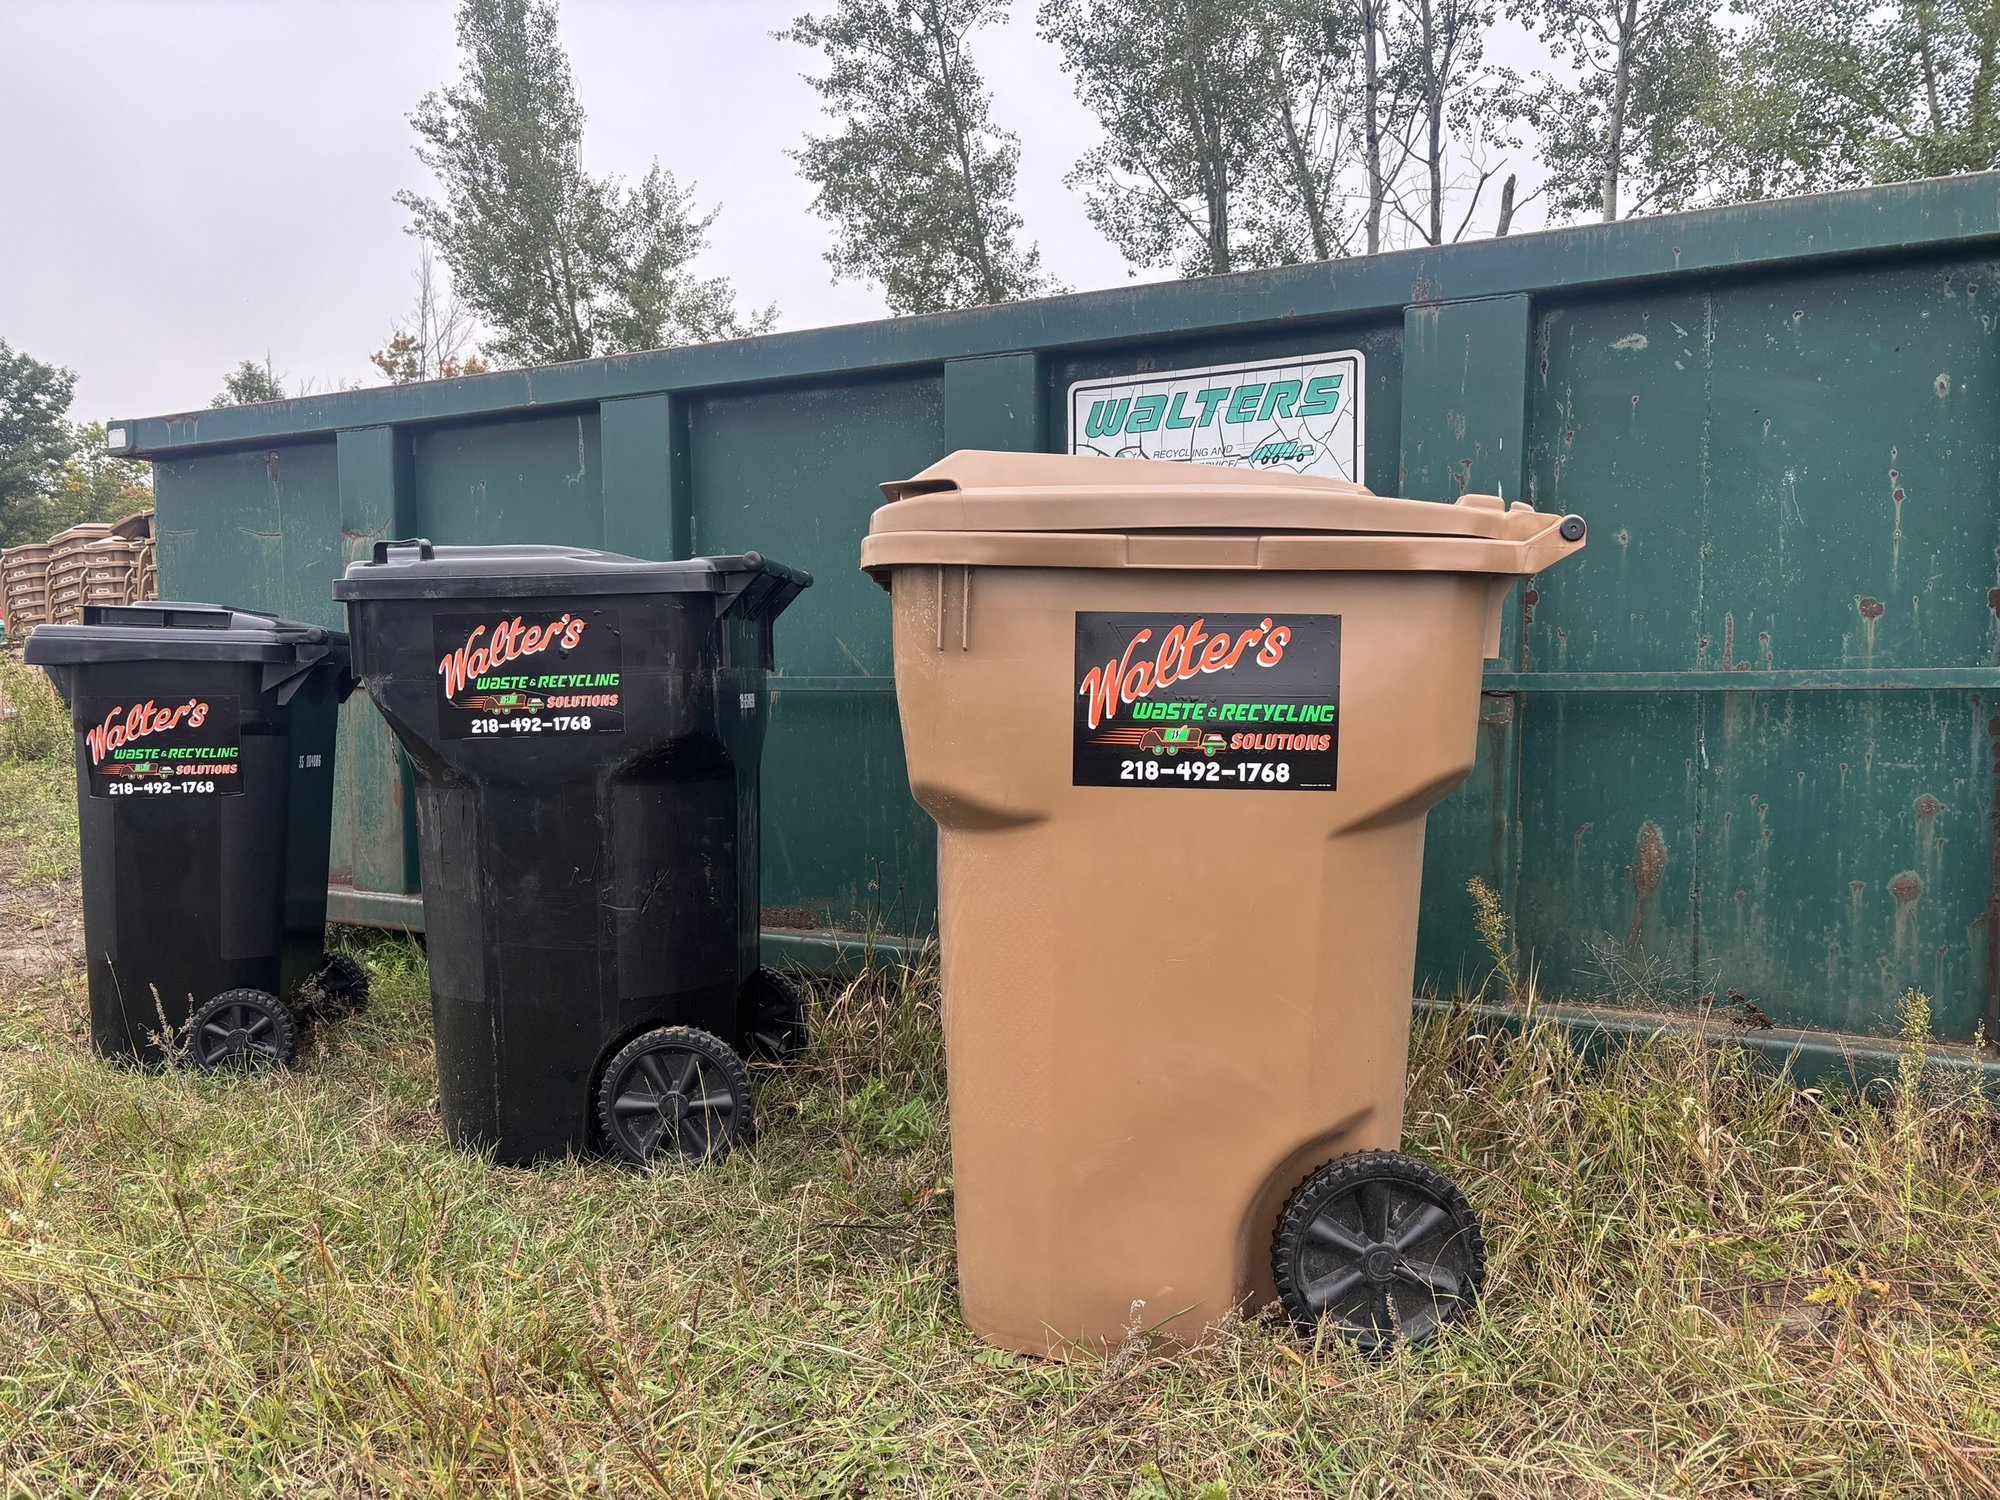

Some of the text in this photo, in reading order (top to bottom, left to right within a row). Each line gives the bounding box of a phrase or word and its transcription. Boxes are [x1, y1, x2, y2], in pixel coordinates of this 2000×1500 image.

[1085, 374, 1344, 438] WALTERS
[1153, 444, 1234, 459] RECYCLING AND
[439, 613, 585, 699] Walter's
[476, 673, 620, 690] WASTE & RECYCLING
[1080, 617, 1291, 730] Walter's
[547, 694, 619, 709] SOLUTIONS
[1132, 702, 1335, 723] WASTE & RECYCLING
[86, 698, 210, 766] Walter's
[471, 715, 592, 733] 218-492-1768
[1230, 733, 1332, 751] SOLUTIONS
[114, 748, 161, 760] WASTE
[168, 747, 239, 759] RECYCLING
[176, 763, 238, 775] SOLUTIONS
[1120, 760, 1290, 783] 218-492-1768
[109, 781, 215, 795] 218-492-1768
